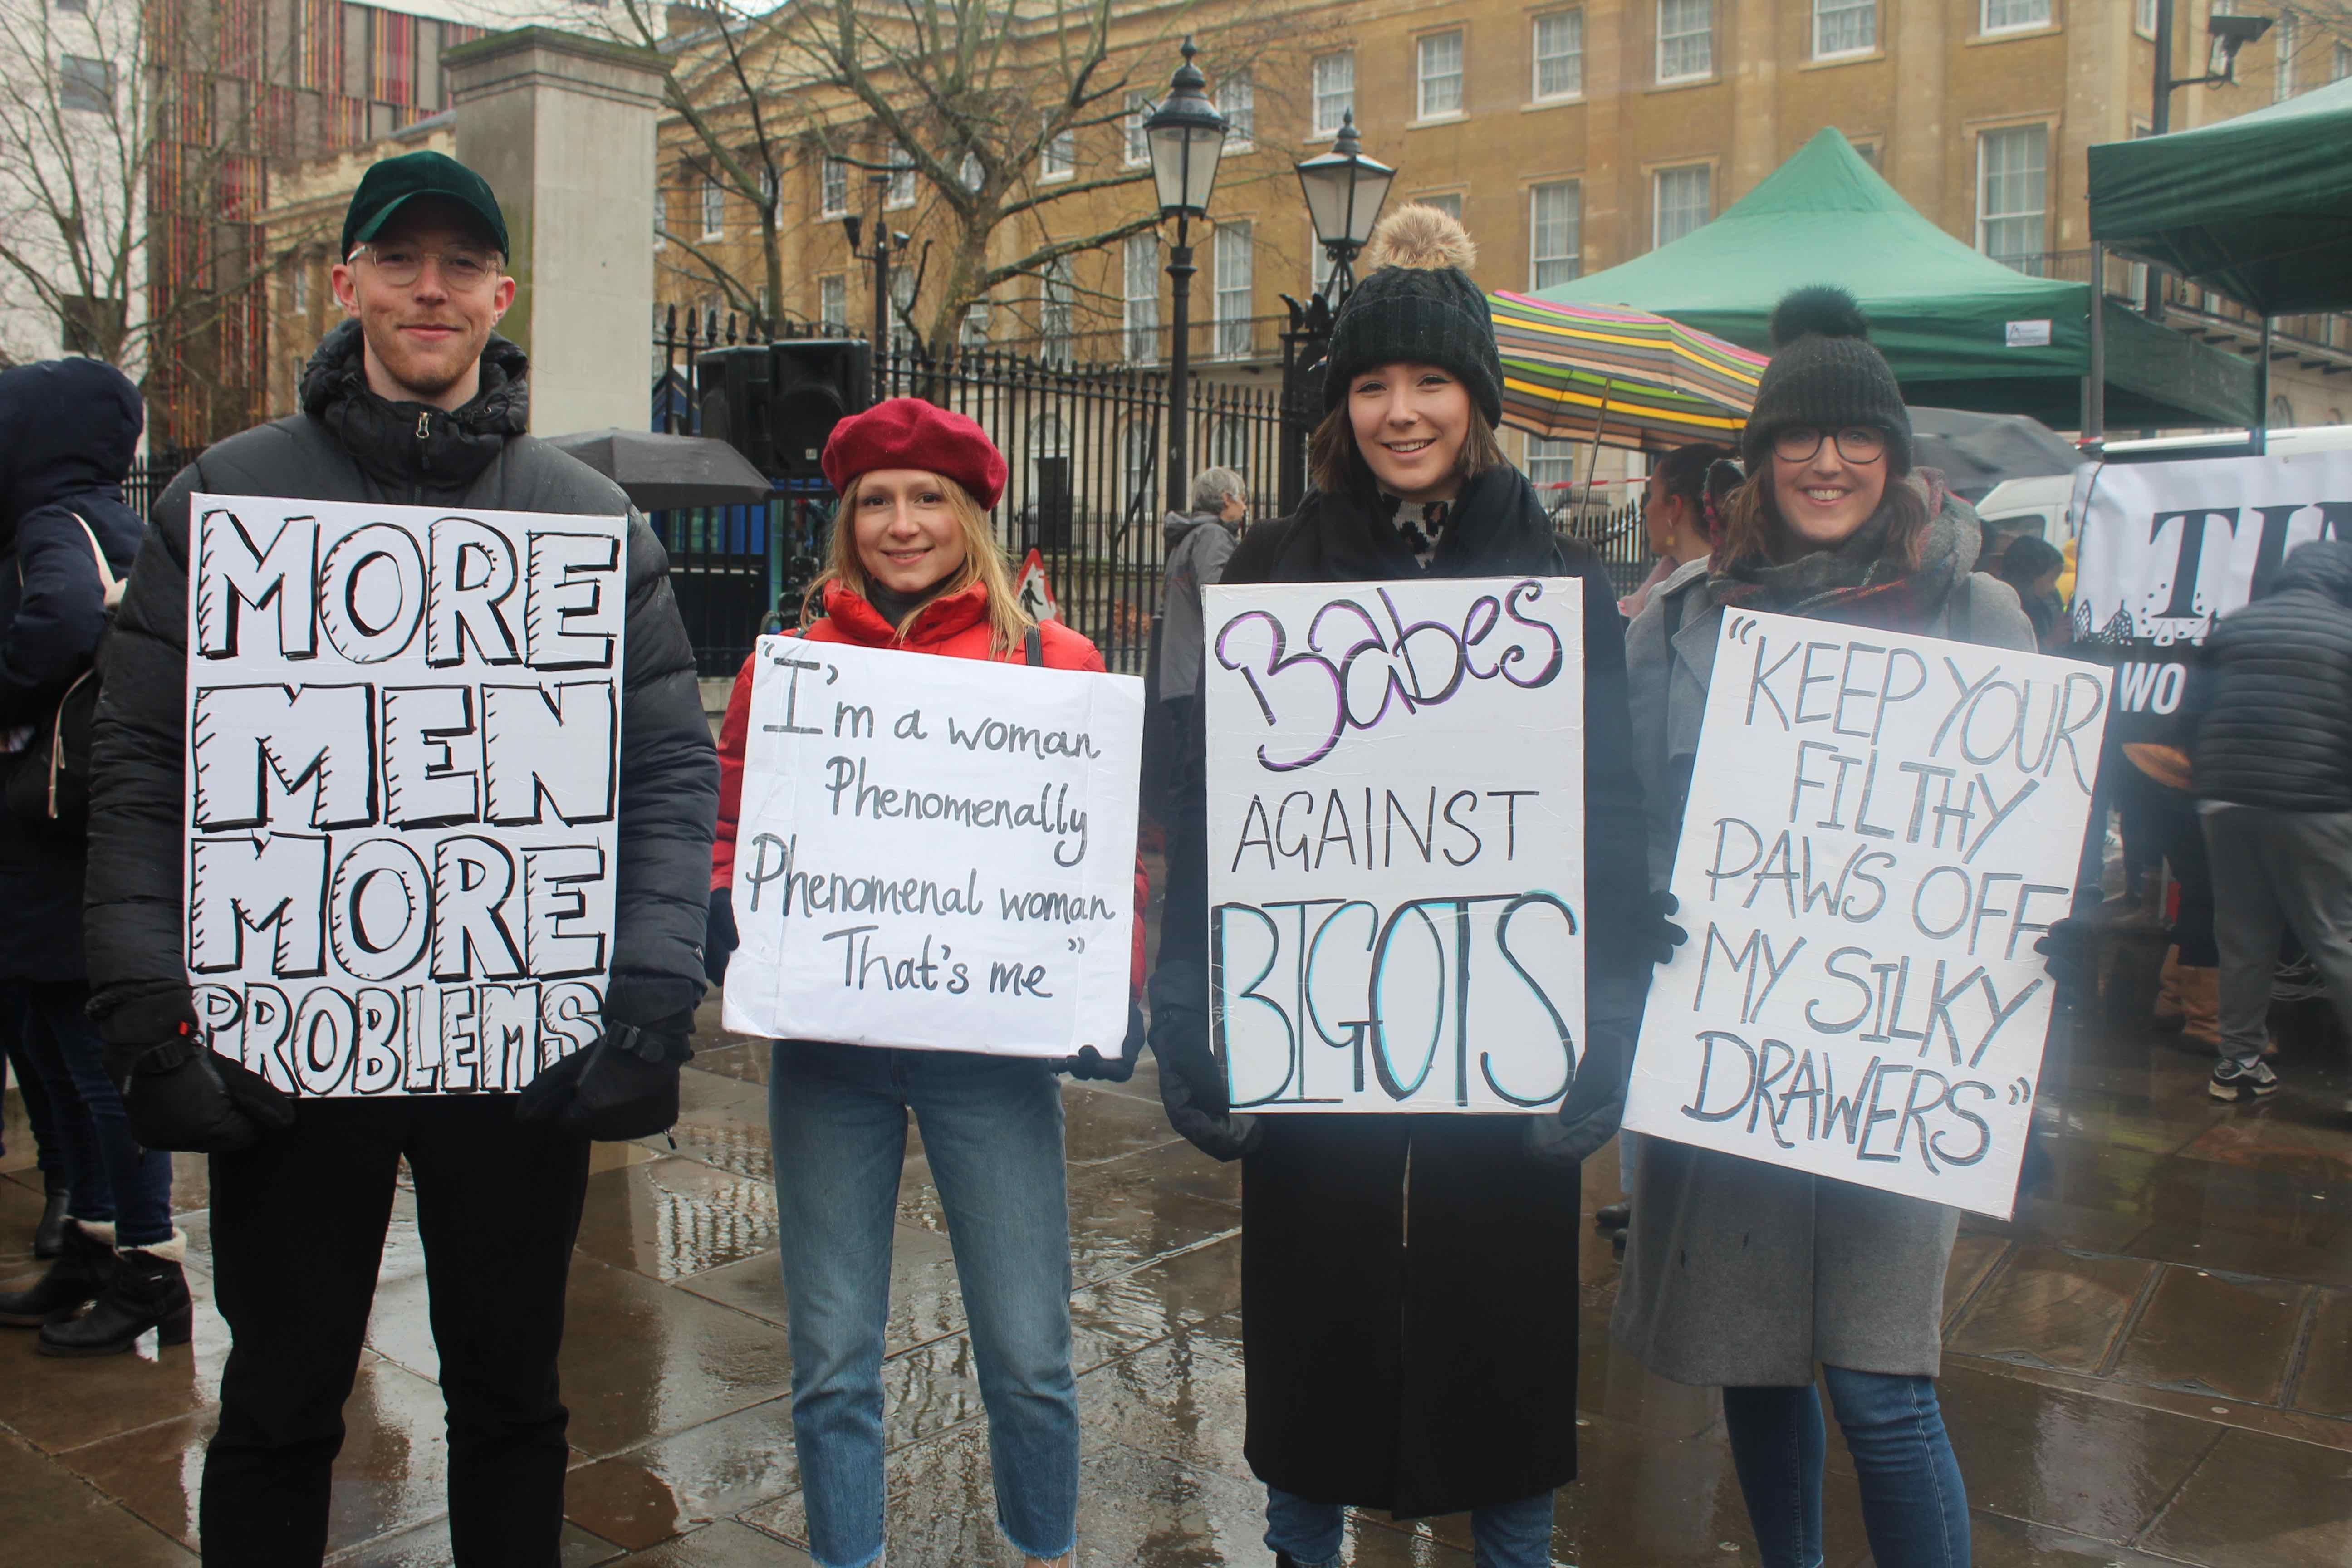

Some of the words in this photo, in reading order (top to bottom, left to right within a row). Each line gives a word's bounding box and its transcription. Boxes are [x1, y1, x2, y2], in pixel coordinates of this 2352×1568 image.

[197, 509, 620, 670] MORE
[191, 677, 616, 832] MEN
[894, 710, 927, 740] a
[948, 717, 1101, 759] woman
[1928, 656, 2104, 796] YOUR
[825, 756, 1087, 867] Phenomenally
[1232, 786, 1539, 872] AGAINST
[1789, 740, 2039, 864] FILTHY
[188, 830, 607, 981] MORE
[745, 833, 983, 917] Phenomenal
[1000, 887, 1116, 923] woman
[1705, 817, 1896, 923] PAWS
[1912, 866, 2069, 961] OFF
[822, 925, 969, 995] That's
[1211, 889, 1579, 1107] BIGOTS
[1692, 921, 1807, 1024] MY
[1804, 945, 2043, 1069] SILKY
[191, 982, 605, 1096] PROBLEMS
